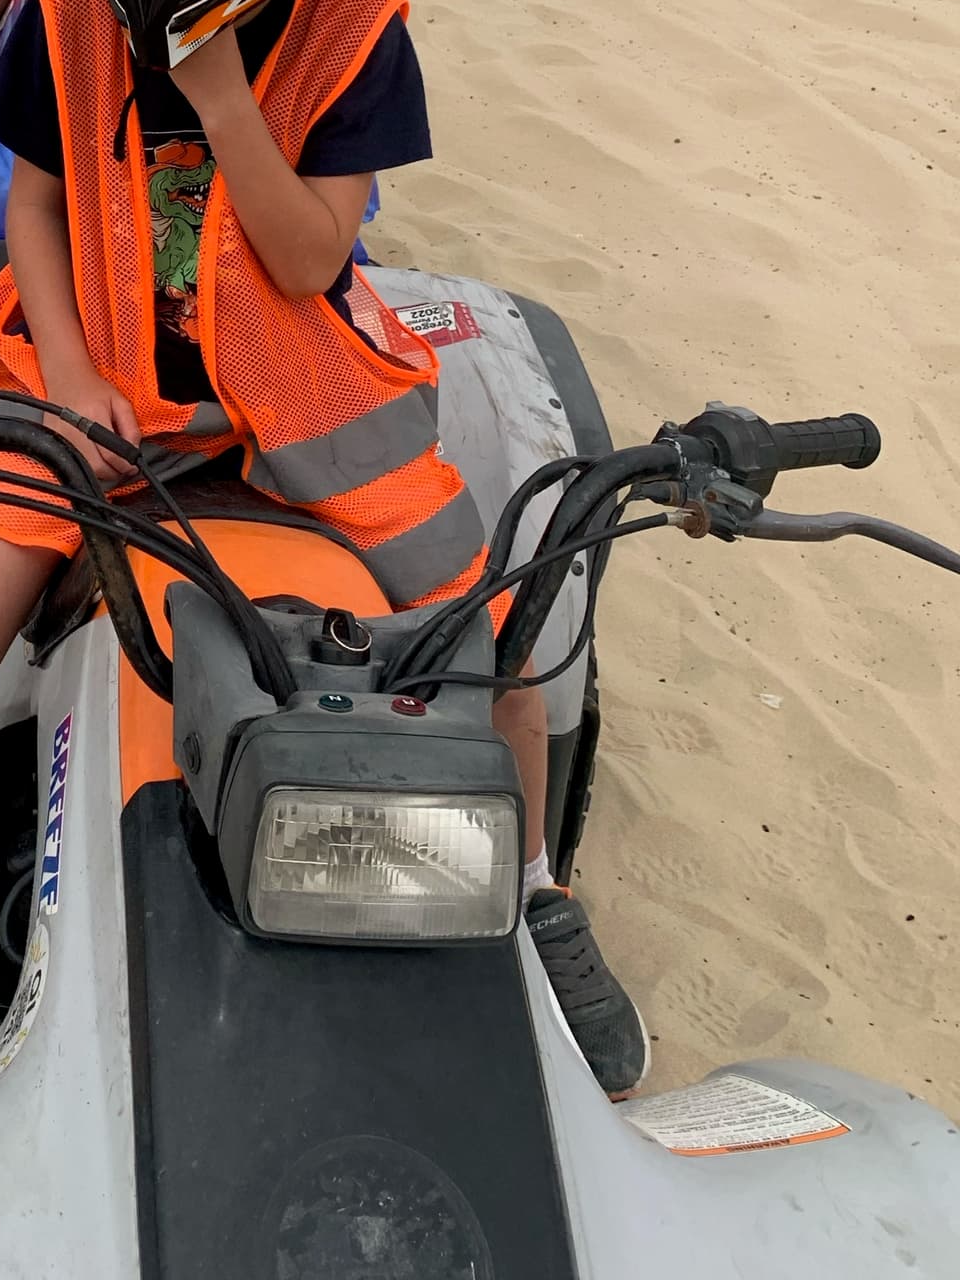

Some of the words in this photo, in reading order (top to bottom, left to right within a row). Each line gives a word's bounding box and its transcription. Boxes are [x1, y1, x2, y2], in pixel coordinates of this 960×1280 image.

[410, 306, 440, 319] 2022
[40, 710, 72, 914] BREEZE
[528, 910, 573, 933] ECHERS
